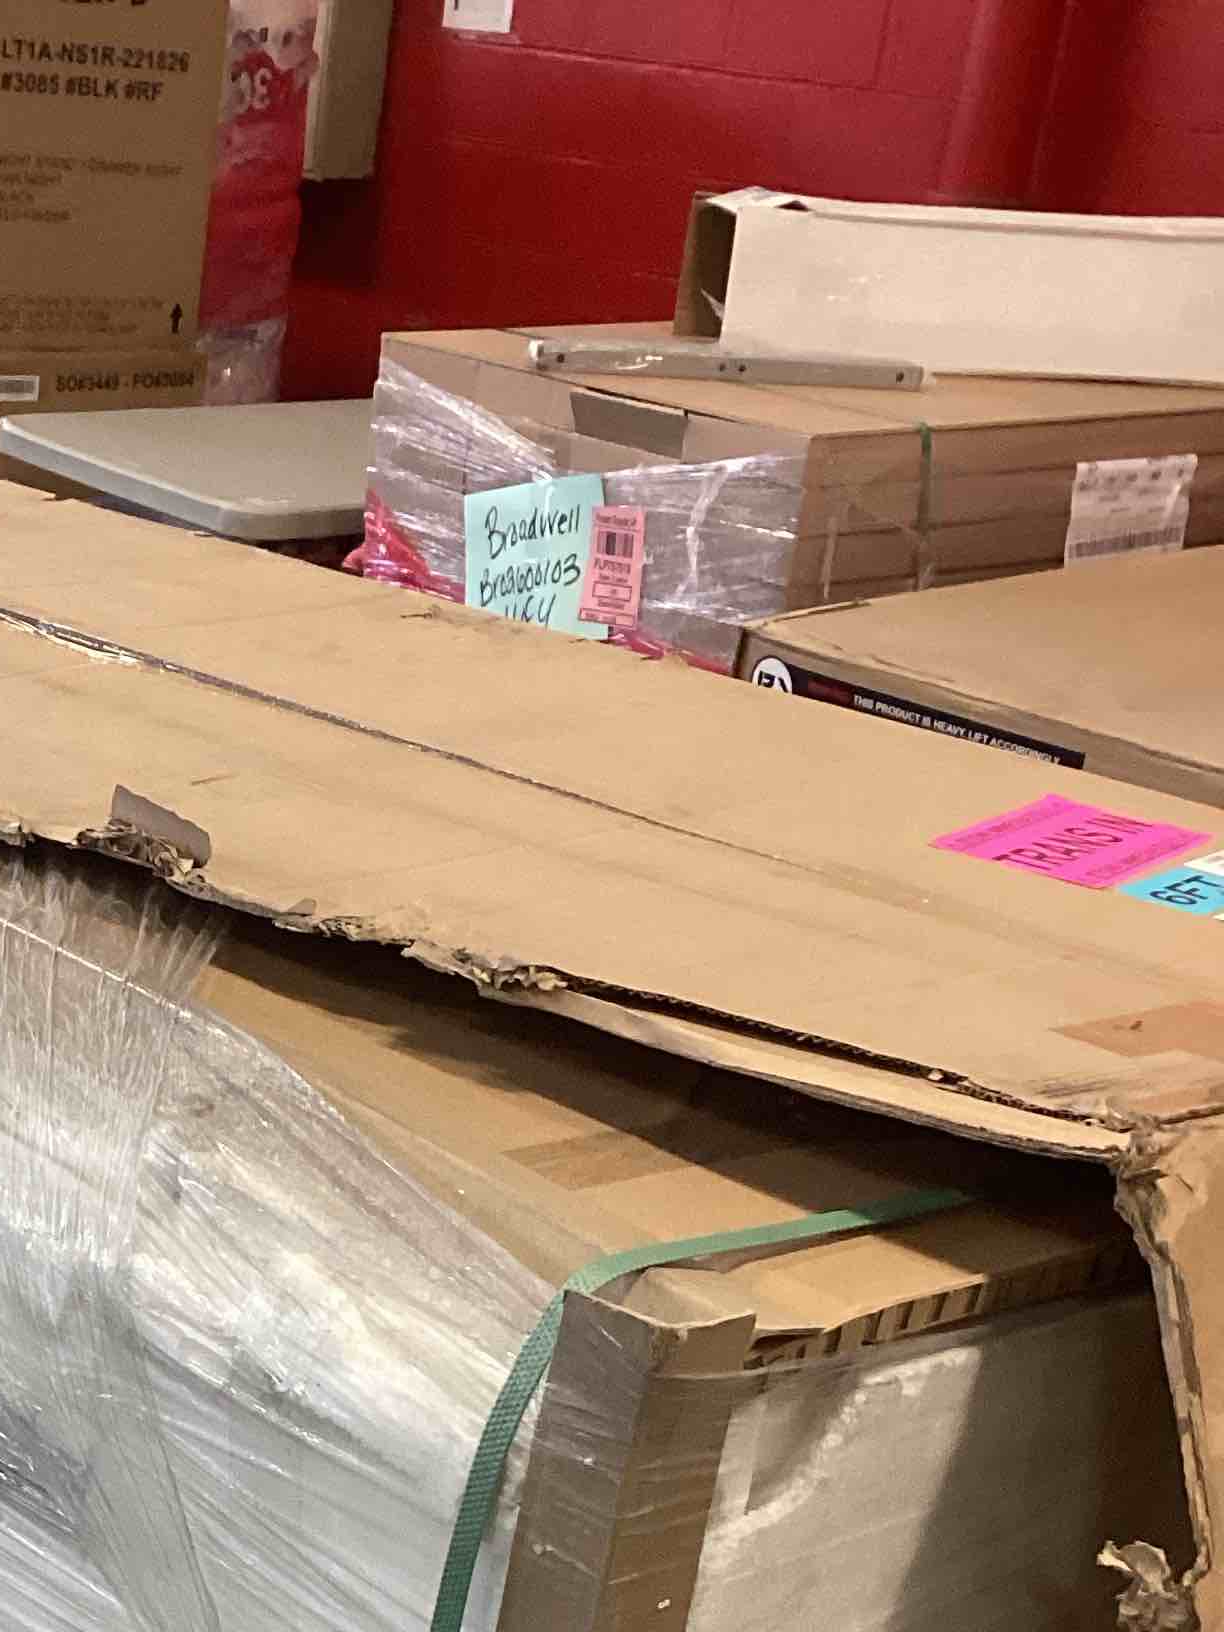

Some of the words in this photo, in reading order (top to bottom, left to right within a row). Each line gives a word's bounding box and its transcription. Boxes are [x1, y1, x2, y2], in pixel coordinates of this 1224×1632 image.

[875, 701, 921, 726] PRODUCT
[967, 730, 989, 745] LIFT
[991, 826, 1125, 871] TRANS
[1149, 875, 1222, 905] 6FT
